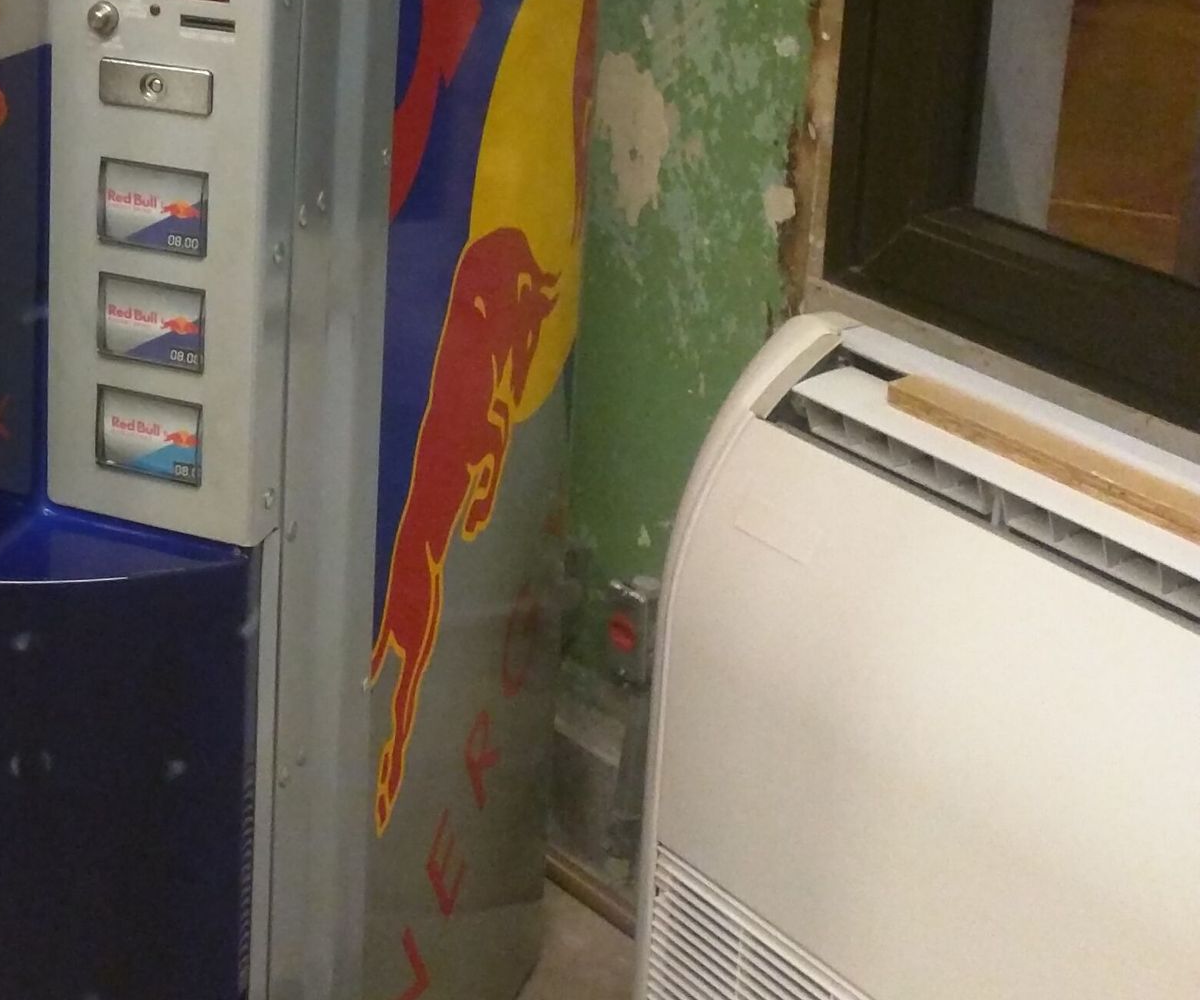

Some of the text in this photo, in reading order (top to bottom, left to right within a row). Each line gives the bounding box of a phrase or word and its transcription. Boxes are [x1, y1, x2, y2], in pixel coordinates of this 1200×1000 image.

[107, 188, 157, 208] Red Bull
[167, 234, 200, 250] 08.00
[108, 303, 133, 319] Red
[134, 308, 158, 324] Bull
[111, 415, 160, 437] Red Bull
